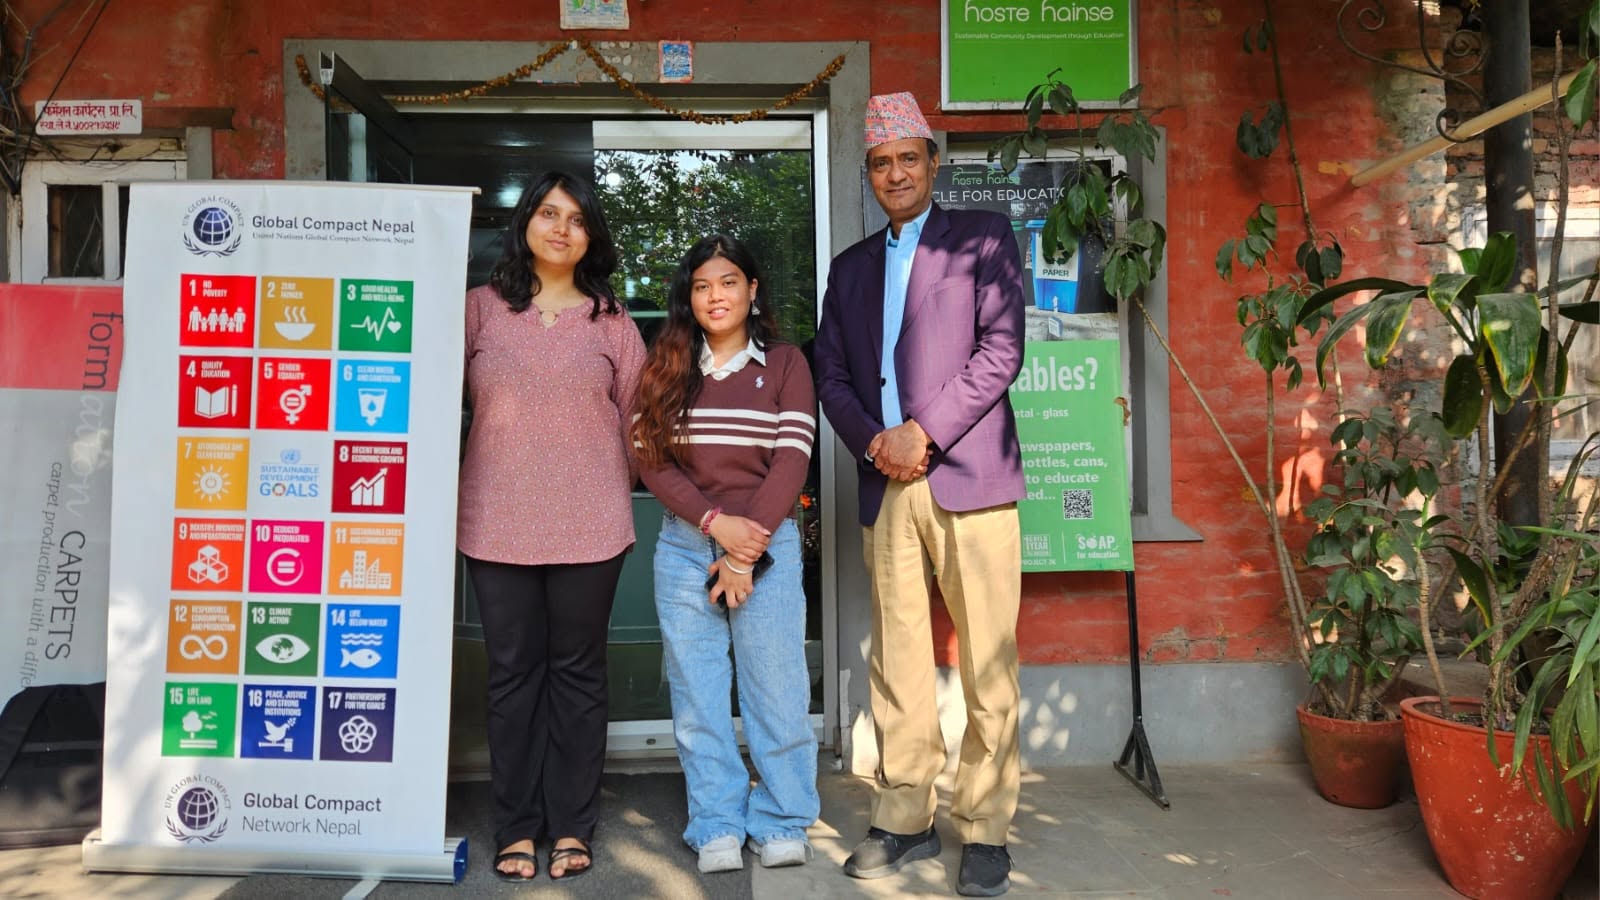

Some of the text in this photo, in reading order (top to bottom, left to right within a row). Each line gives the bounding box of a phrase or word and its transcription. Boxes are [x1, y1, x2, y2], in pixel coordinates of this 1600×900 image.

[1041, 0, 1114, 23] hainse
[990, 32, 1025, 41] Community
[1026, 32, 1067, 41] Development
[1068, 32, 1092, 40] through
[963, 189, 992, 201] FOR
[252, 215, 415, 235] Global Compact Nepal
[1043, 269, 1070, 278] PAPER
[189, 279, 197, 296] 1
[203, 289, 228, 297] POVERTY
[267, 281, 276, 298] 2
[347, 284, 356, 301] 3
[186, 360, 197, 378] 4
[264, 362, 273, 379] 5
[343, 365, 353, 381] 6
[1010, 356, 1099, 392] ables?
[1043, 408, 1069, 420] glass
[184, 442, 193, 459] 7
[339, 446, 349, 462] 8
[260, 465, 319, 473] SUSTAINABLE
[1073, 456, 1108, 468] cans,
[46, 462, 62, 506] carpet
[1026, 472, 1099, 484] to educate
[260, 482, 319, 497] GOALS
[179, 523, 187, 540] 9
[255, 525, 271, 542] 10
[336, 528, 346, 544] 11
[35, 509, 57, 592] production
[45, 530, 86, 660] CARPETS
[30, 597, 45, 632] with
[174, 605, 187, 622] 12
[251, 607, 265, 624] 13
[331, 609, 346, 626] 14
[26, 636, 38, 646] a
[169, 687, 183, 704] 15
[248, 690, 262, 707] 16
[328, 692, 342, 709] 17
[171, 774, 201, 795] GLOBAL
[204, 776, 231, 809] COMPACT
[243, 793, 382, 814] Global Compact
[242, 816, 361, 837] Network Nepal
